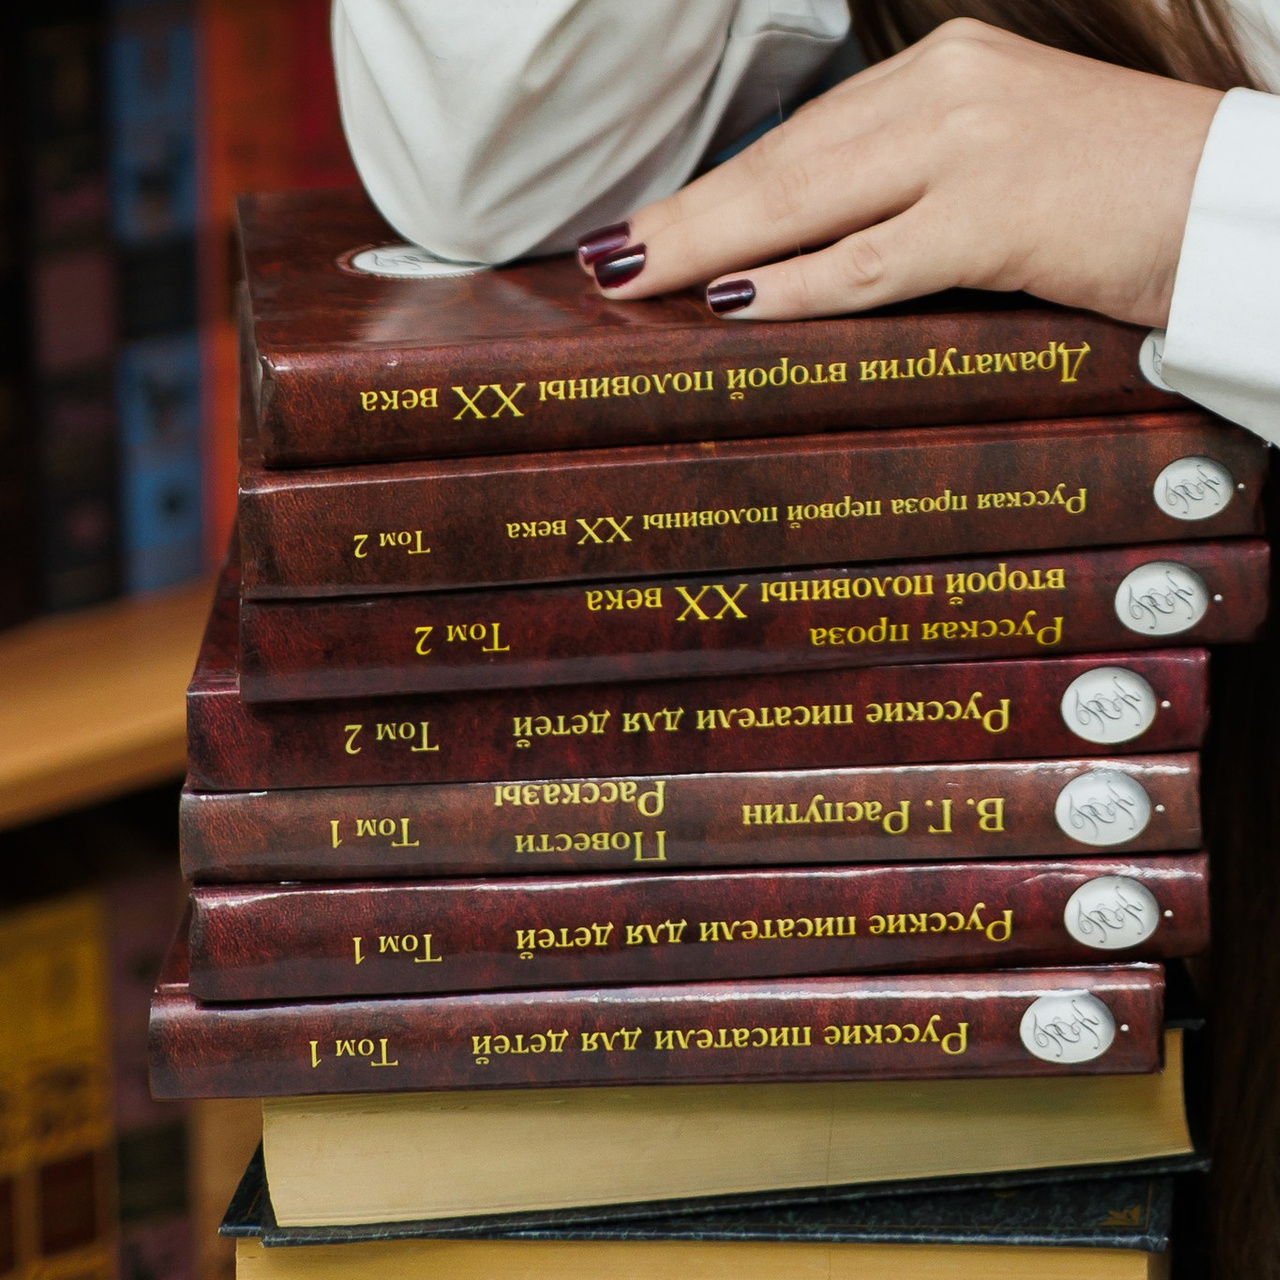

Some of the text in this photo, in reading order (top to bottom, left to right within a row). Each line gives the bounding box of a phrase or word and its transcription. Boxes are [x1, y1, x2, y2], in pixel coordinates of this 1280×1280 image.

[858, 341, 1091, 383] Драматургия
[538, 370, 714, 402] половины
[725, 357, 848, 401] второй
[359, 387, 439, 412] века
[786, 495, 882, 529] первой
[890, 489, 968, 515] проза
[976, 482, 1088, 514] Русская
[505, 519, 567, 539] века
[642, 506, 778, 530] половины
[353, 530, 431, 559] Том 2
[585, 587, 663, 612] века
[760, 574, 935, 604] половины
[945, 562, 1066, 606] второй
[414, 622, 511, 656] Том 2
[809, 609, 1064, 646] Русская проза
[512, 691, 1011, 749] Русские писатели для детей
[344, 721, 440, 755] Том 2
[493, 779, 667, 818] Рассказы
[740, 793, 1006, 835] В. Г. Распутин
[329, 817, 420, 850] Том 1
[513, 830, 667, 863] Повести
[515, 901, 1014, 960] Русские писатели для детей
[352, 933, 443, 965] Том 1
[308, 1037, 399, 1069] Том 1
[471, 1013, 969, 1066] Русские писатели для детей
